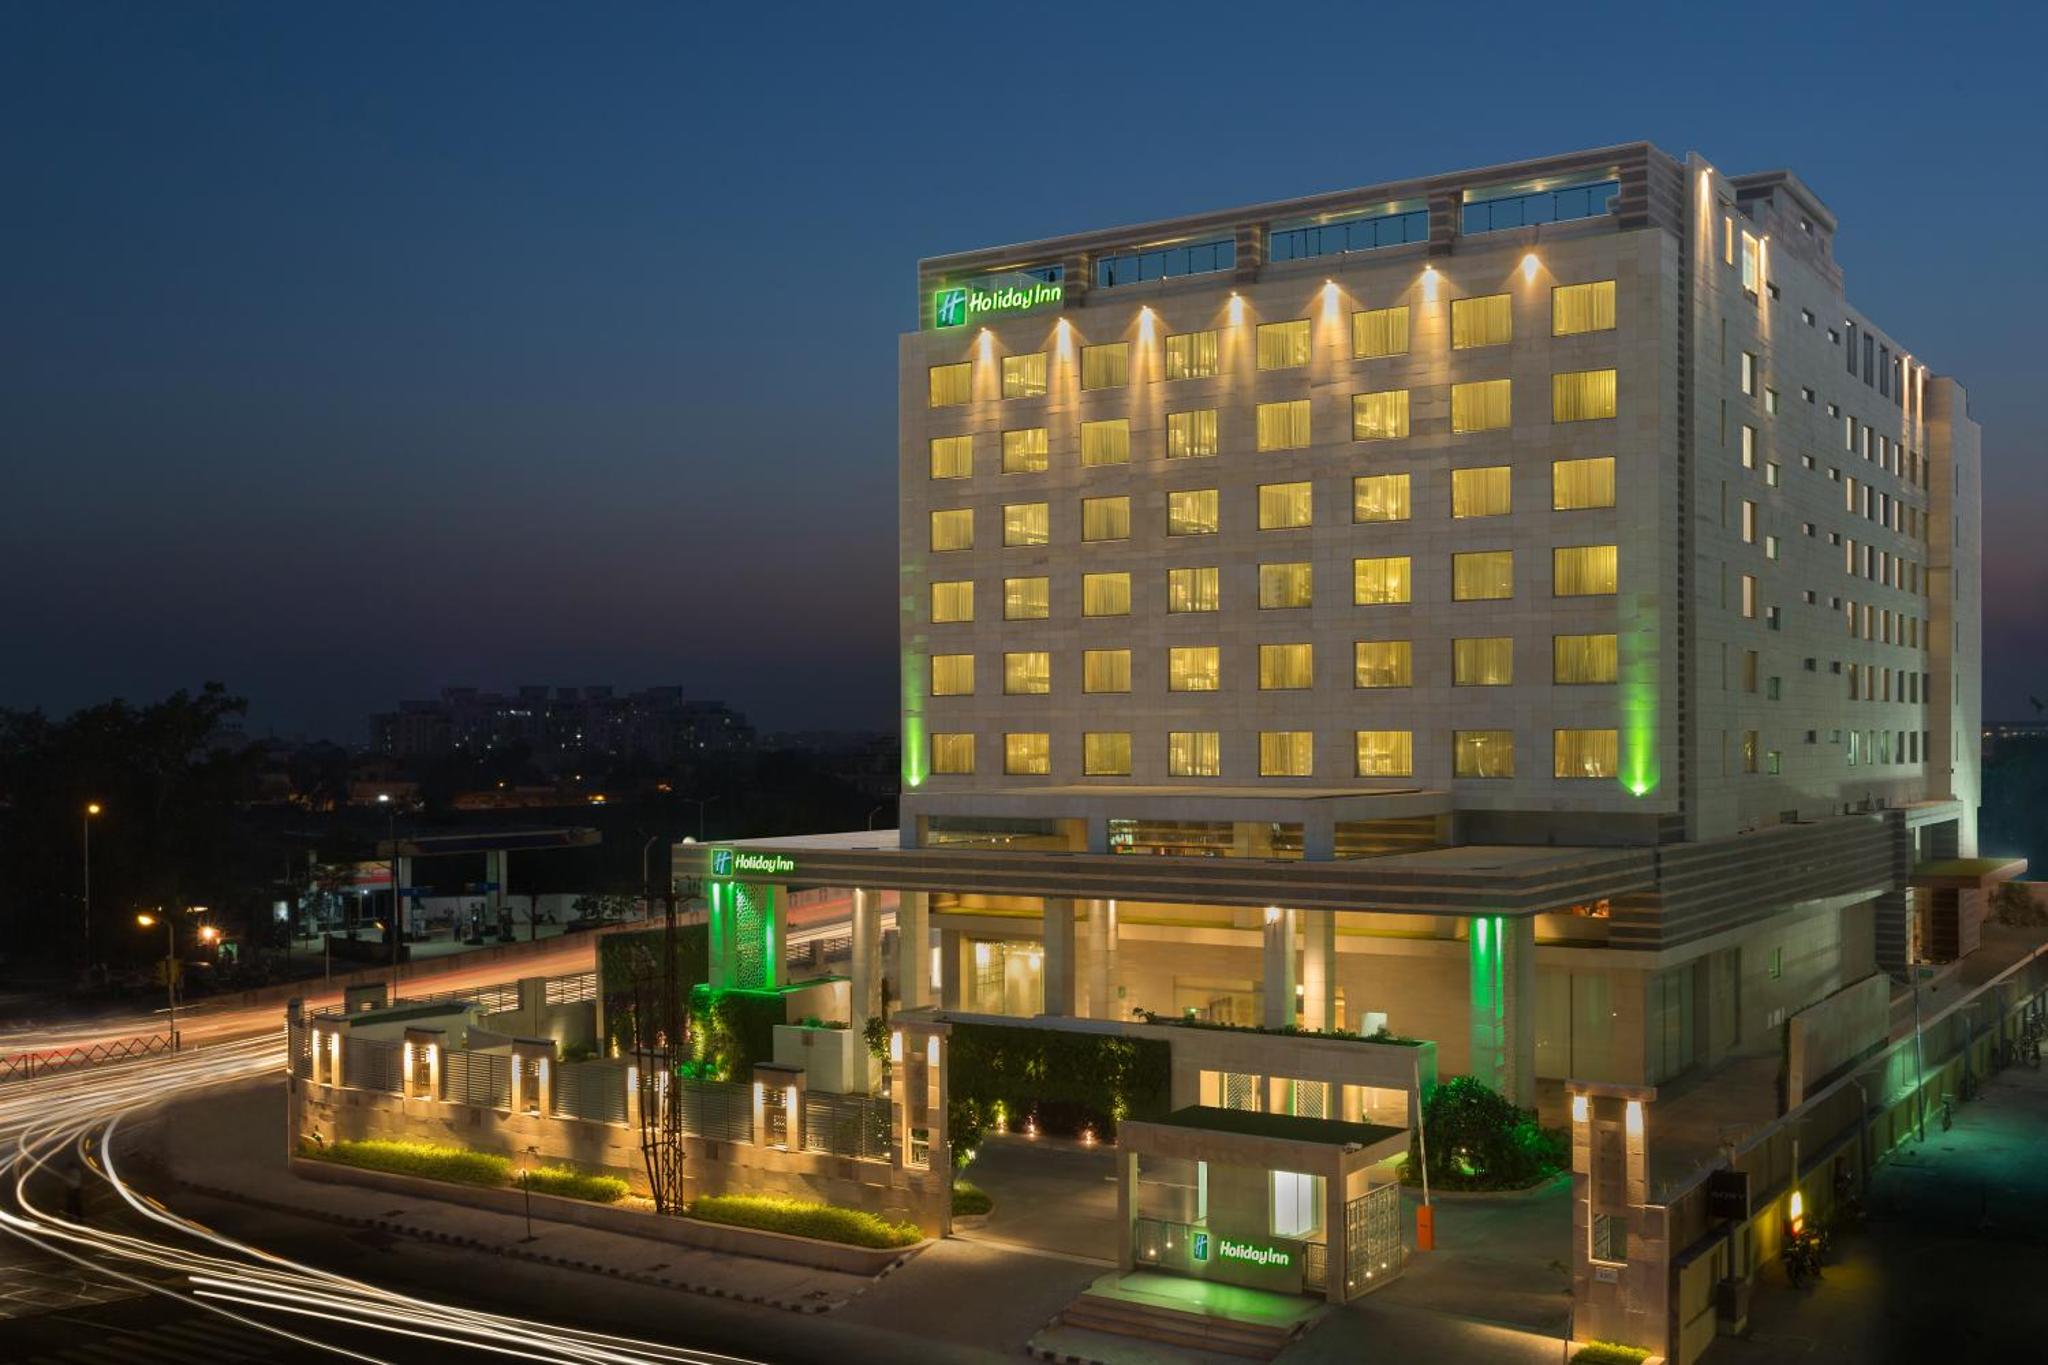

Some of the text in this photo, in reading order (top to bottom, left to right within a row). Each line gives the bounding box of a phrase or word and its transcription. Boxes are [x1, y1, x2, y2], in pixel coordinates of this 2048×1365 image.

[969, 287, 1032, 312] Holiday
[1034, 283, 1061, 304] Inn
[735, 854, 775, 872] Holiday
[776, 855, 794, 871] Inn
[1220, 1241, 1267, 1264] Holiday
[1268, 1247, 1289, 1265] Inn
